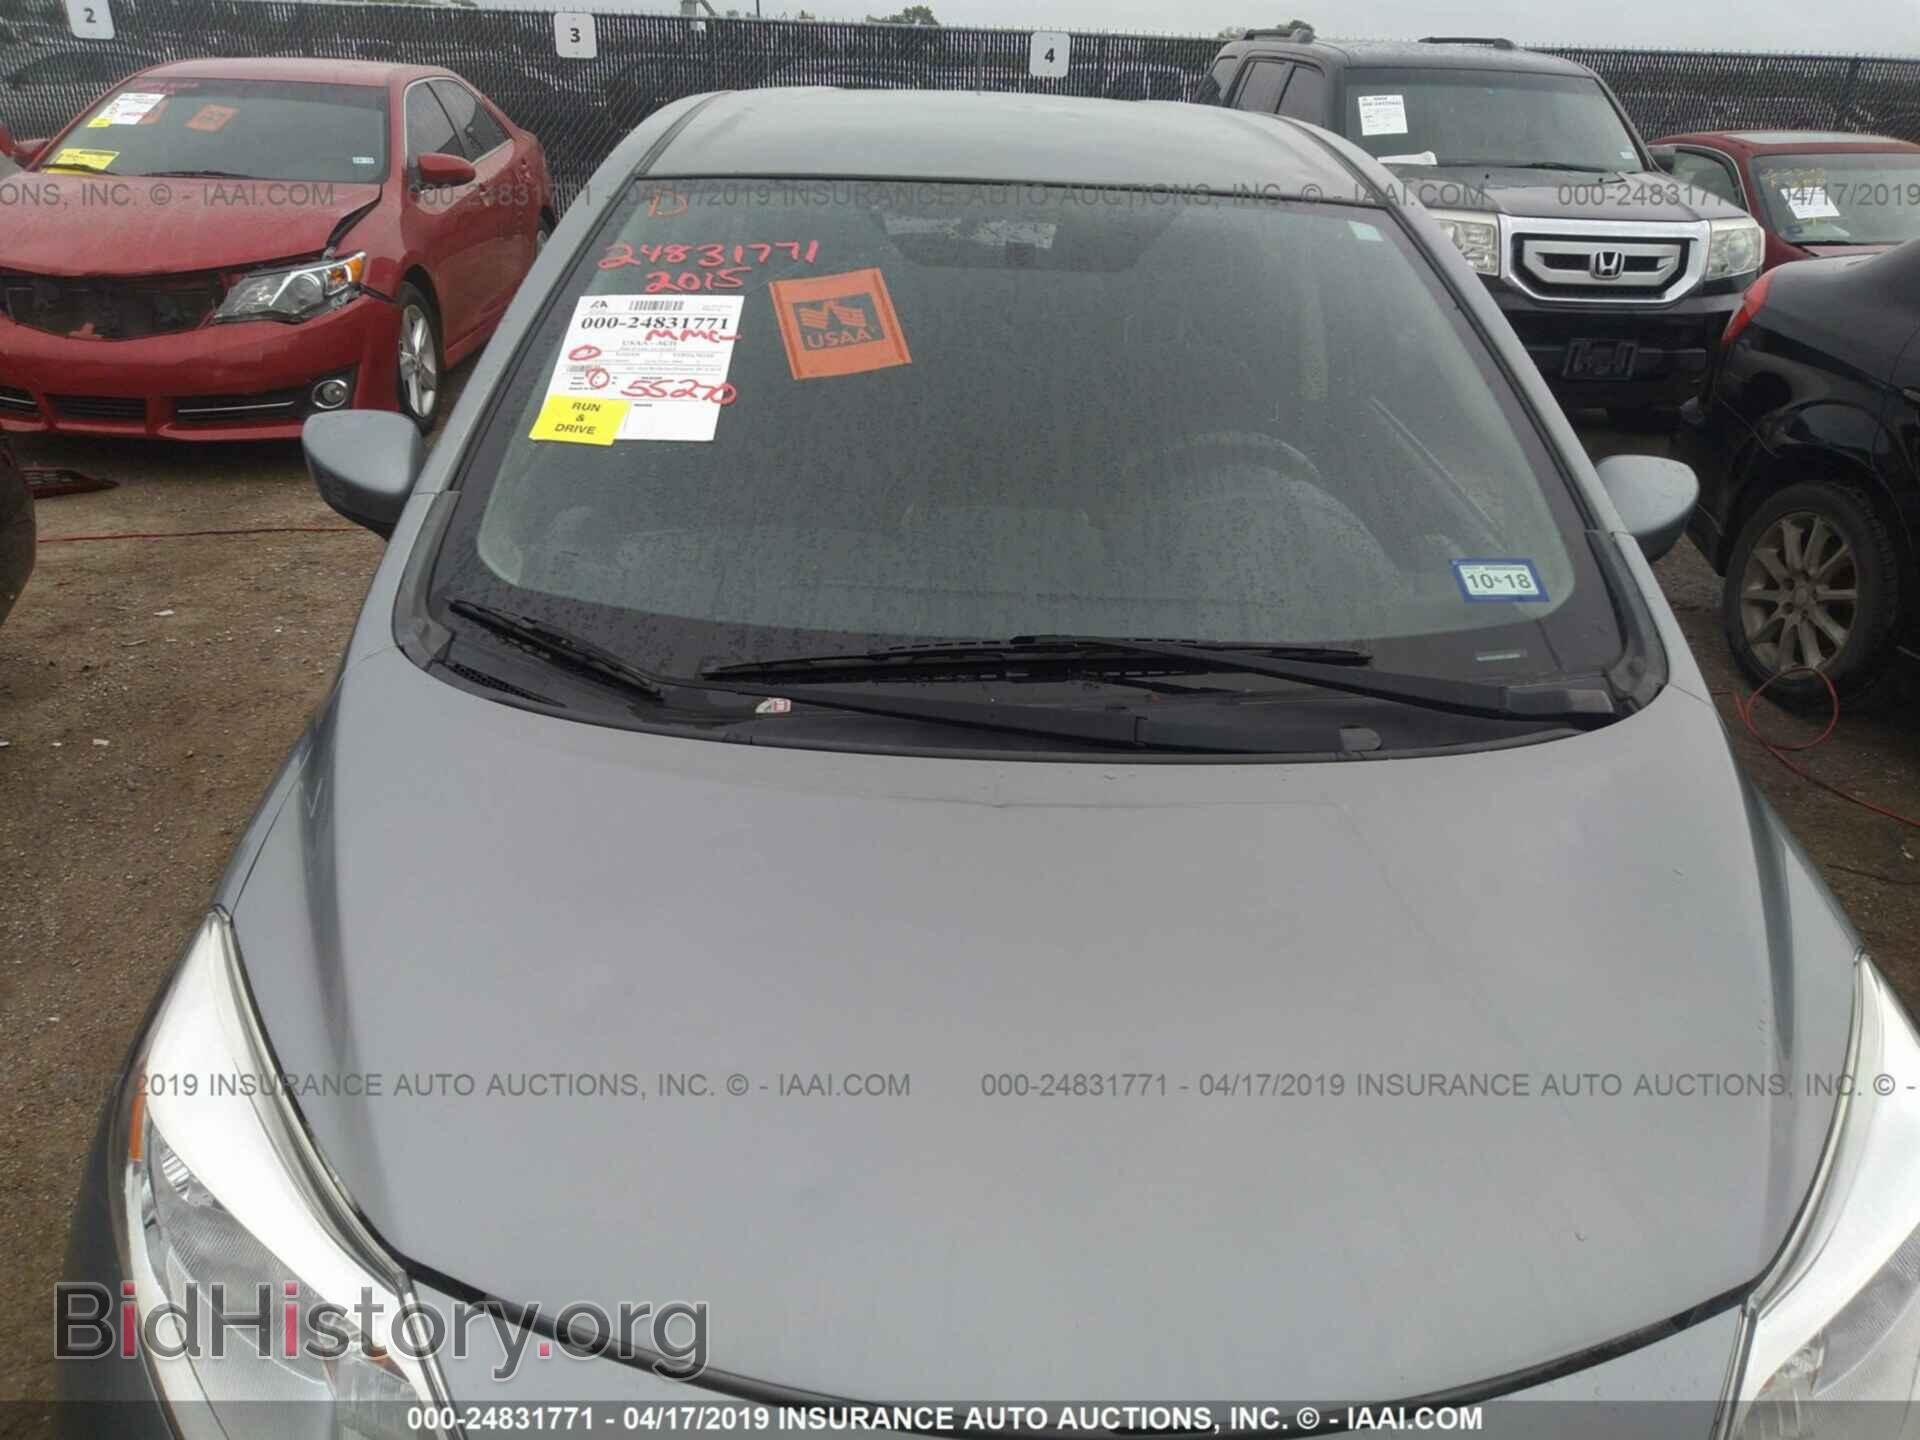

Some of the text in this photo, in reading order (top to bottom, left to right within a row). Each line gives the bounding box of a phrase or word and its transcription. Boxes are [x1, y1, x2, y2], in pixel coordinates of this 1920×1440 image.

[84, 8, 96, 23] 2
[570, 27, 581, 44] 3
[1043, 46, 1055, 64] 4
[598, 239, 819, 268] 24831771
[645, 267, 752, 292] 2015
[581, 316, 728, 329] 000-24831771
[807, 328, 872, 348] USAA
[572, 402, 600, 412] RUN
[576, 414, 585, 422] &
[555, 423, 596, 435] DRIVE
